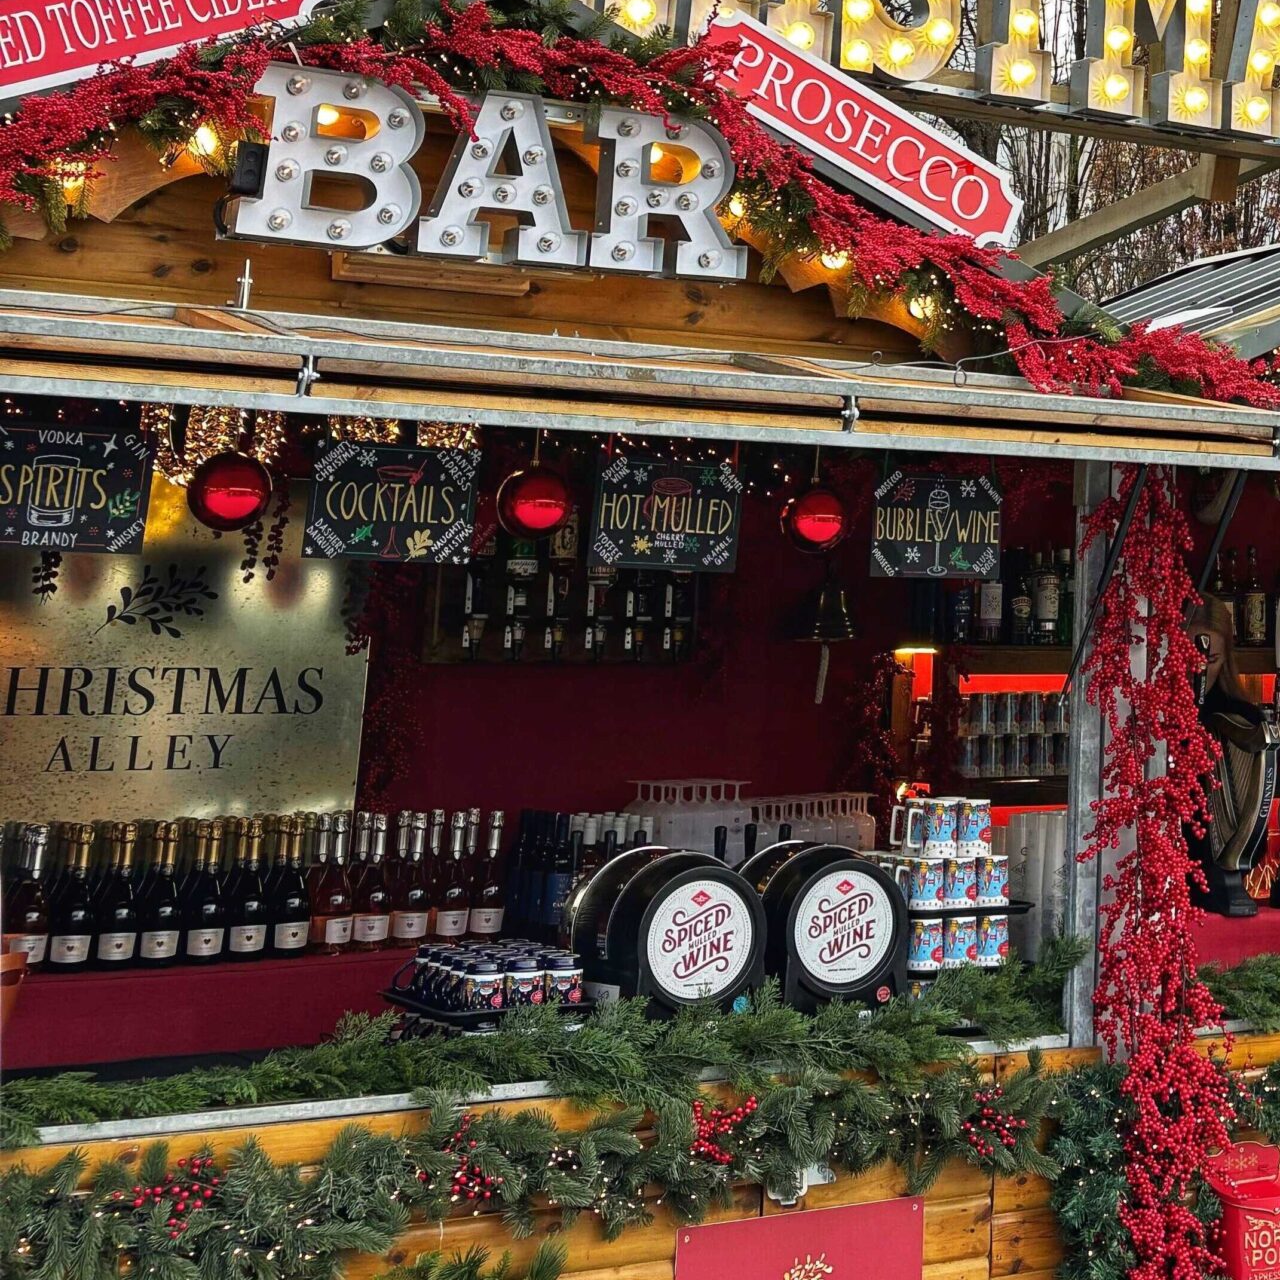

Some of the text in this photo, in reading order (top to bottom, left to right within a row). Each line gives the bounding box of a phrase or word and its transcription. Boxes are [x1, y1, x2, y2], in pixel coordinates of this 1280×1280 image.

[723, 33, 991, 220] PROSECCO
[233, 60, 748, 281] BAR
[38, 430, 84, 446] VODKA
[124, 434, 150, 460] GIN
[314, 439, 351, 471] NAUGHTY
[315, 444, 360, 482] CHRISTMAS
[436, 451, 471, 492] EXPRESS
[450, 449, 476, 480] SANTA
[601, 456, 628, 481] SPICED
[719, 462, 744, 494] CARAMEL
[0, 464, 107, 509] SPIRITS
[718, 474, 734, 493] RUM
[874, 470, 903, 500] PROSECCO
[325, 481, 455, 524] COCKTAILS
[600, 493, 733, 535] HOT MULLED
[21, 531, 78, 548] BRANDY
[106, 518, 146, 552] WHISKEY
[306, 525, 339, 559] DAIQUIRI
[314, 518, 346, 554] DASHERS
[431, 517, 466, 553] NAUGHTY
[434, 523, 474, 564] CHRISTMAS
[597, 531, 623, 562] TOFFEE
[702, 535, 733, 566] BRAMBLE
[593, 541, 614, 565] CIDER
[714, 551, 730, 567] GIN
[871, 548, 895, 577] PROSECCO
[972, 546, 994, 573] BLUSH
[40, 734, 235, 773] ALLEY
[1259, 766, 1274, 819] GUINNESS
[661, 904, 732, 953] SPICED
[808, 893, 874, 939] SPICED
[832, 918, 861, 938] MULLED
[677, 930, 735, 977] WINE
[688, 930, 717, 950] MULLED
[822, 919, 877, 962] WINE
